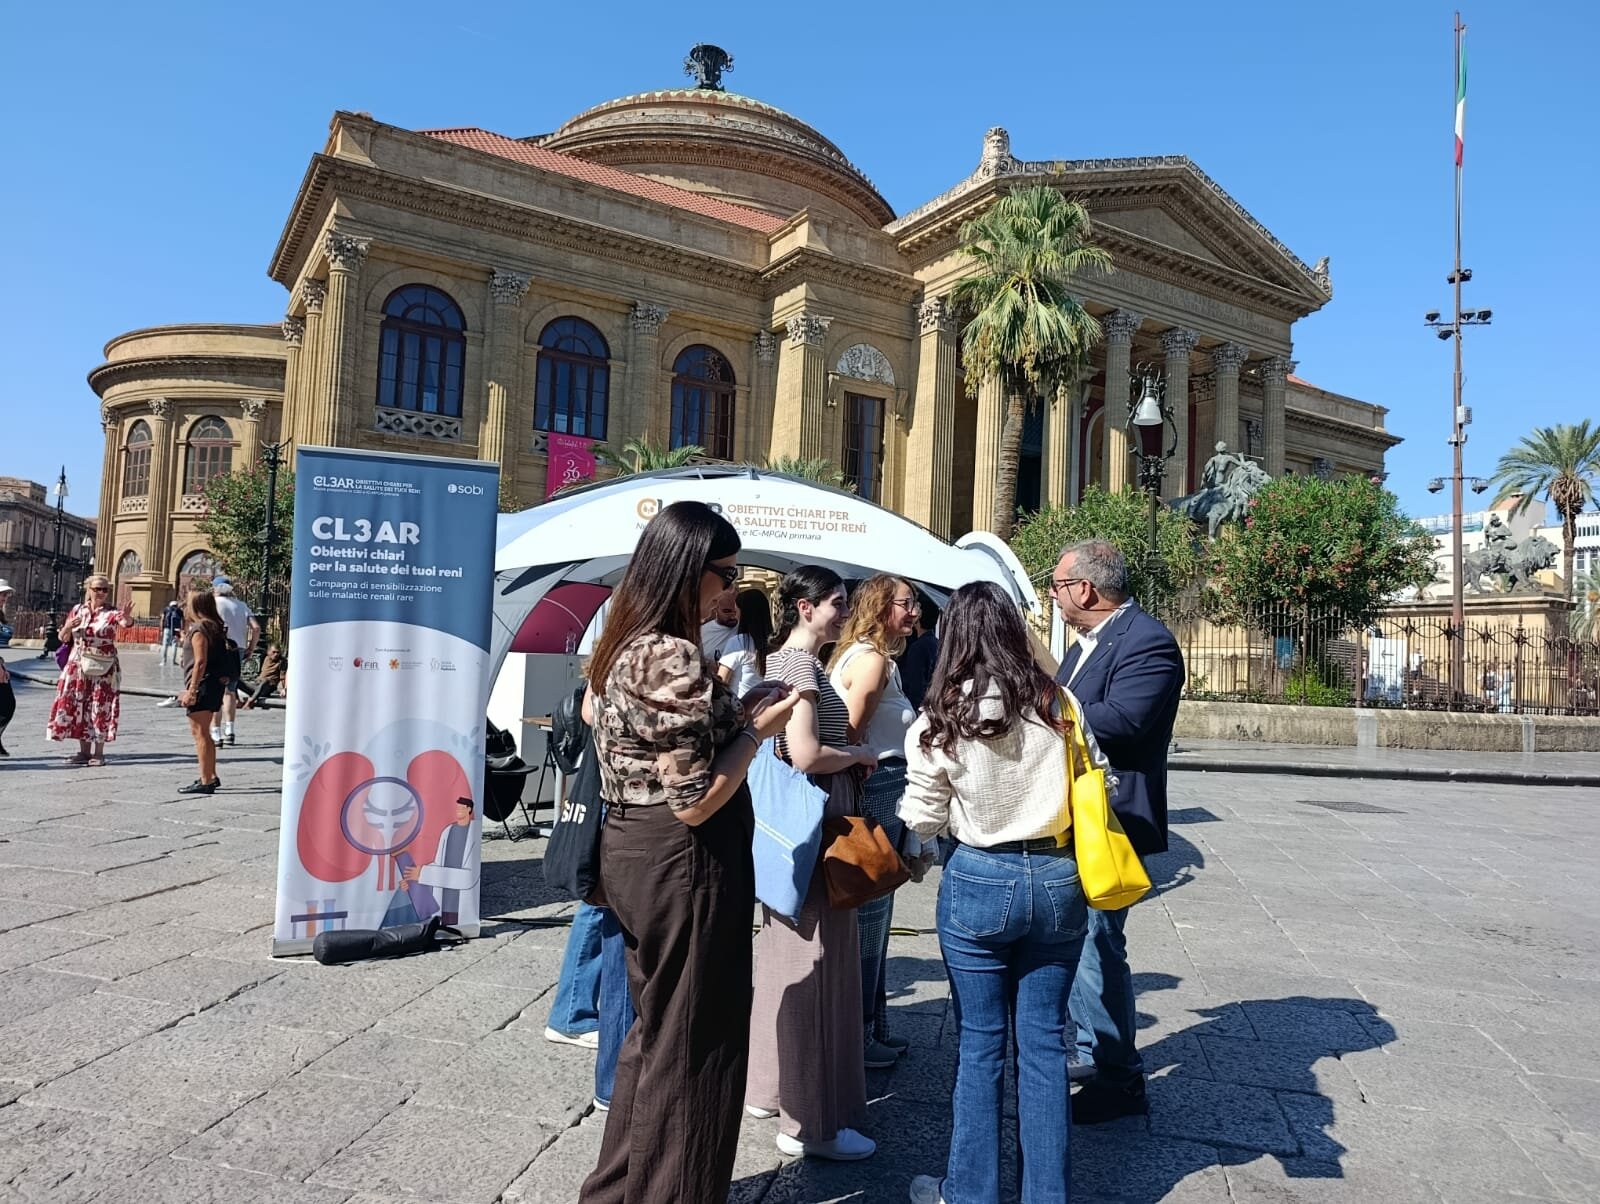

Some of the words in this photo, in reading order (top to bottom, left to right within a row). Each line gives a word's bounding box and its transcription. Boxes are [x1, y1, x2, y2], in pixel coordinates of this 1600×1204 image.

[457, 484, 484, 496] sobi
[727, 504, 784, 517] OBIETTIVI
[787, 507, 826, 519] CHIARI
[829, 510, 849, 521] PER
[311, 516, 420, 545] CL3AR
[744, 516, 786, 528] SALUTE
[789, 519, 808, 530] DEI
[810, 521, 838, 532] TUOI
[749, 529, 788, 539] IC-MPGN
[788, 533, 822, 541] primaria
[310, 545, 368, 559] Obiettivi
[370, 549, 405, 561] chiari
[310, 562, 332, 573] per
[334, 560, 347, 572] la
[349, 562, 388, 574] salute
[390, 563, 410, 575] dei
[412, 565, 436, 576] tuoi
[438, 567, 463, 577] reni
[309, 578, 358, 589] Campagna
[360, 581, 369, 589] di
[370, 582, 442, 593] sensibilizzazione
[308, 590, 330, 598] sulle
[332, 591, 369, 600] malattie
[370, 593, 395, 601] renali
[396, 594, 414, 602] rare
